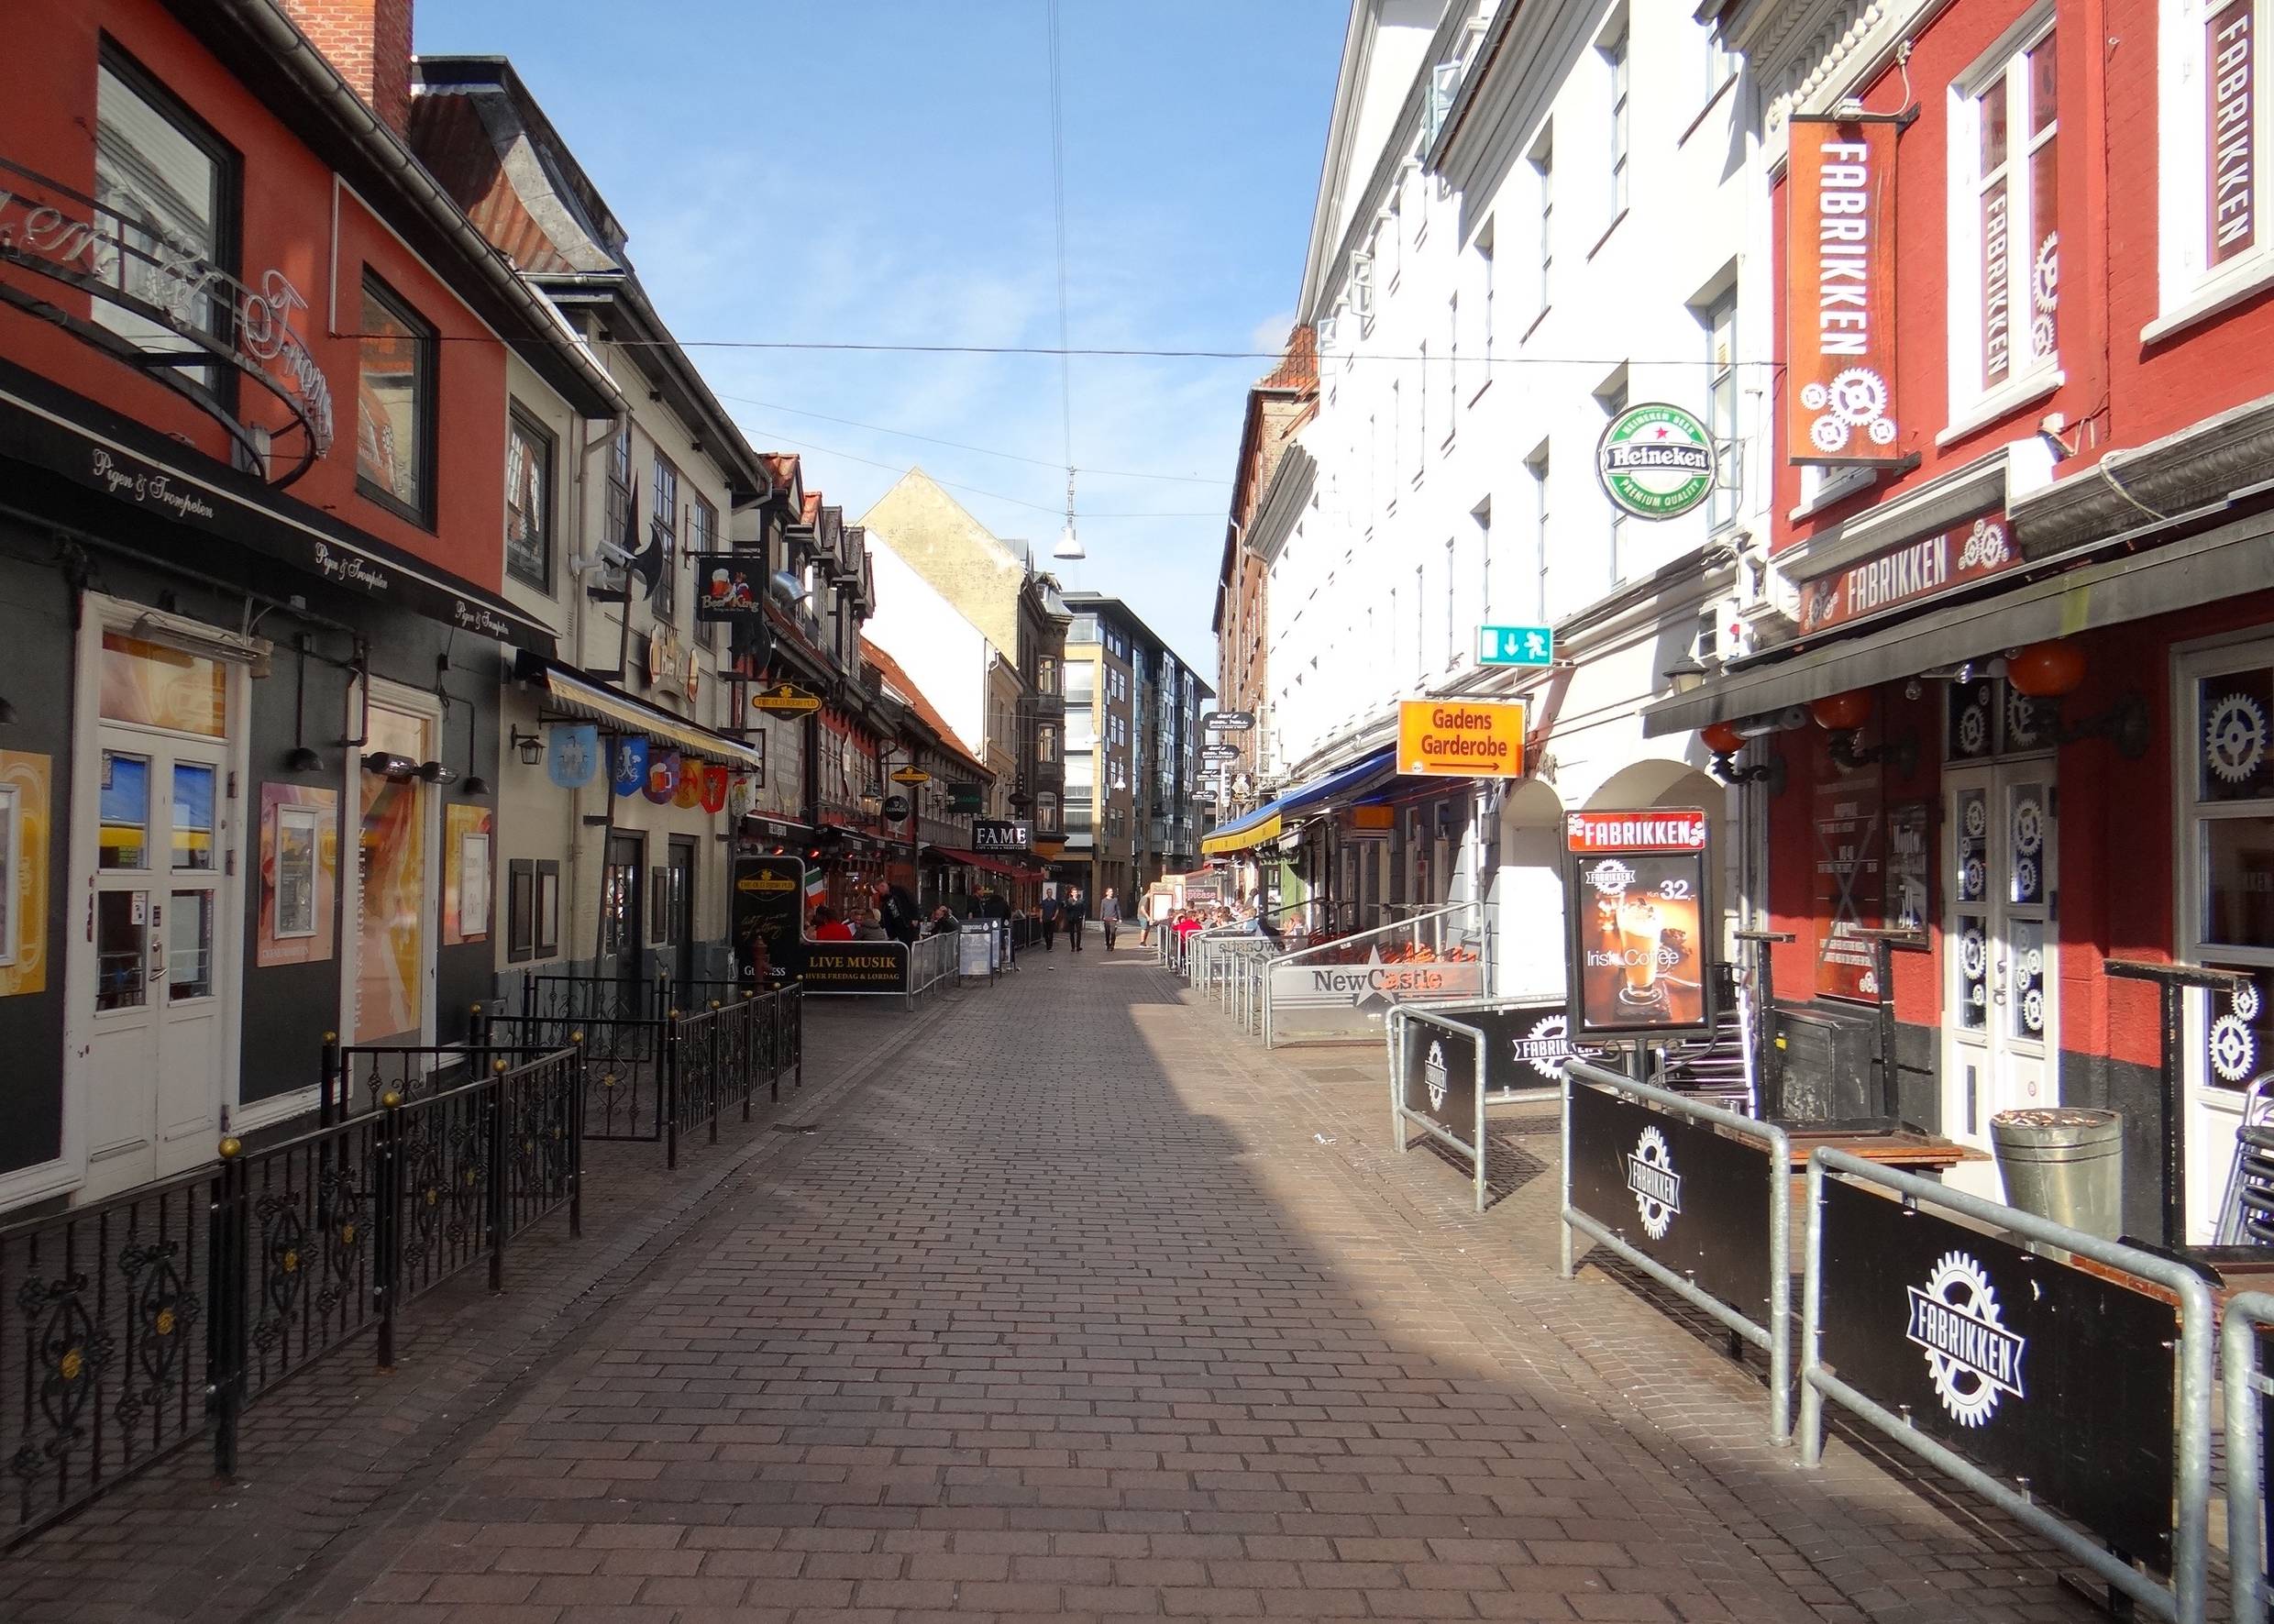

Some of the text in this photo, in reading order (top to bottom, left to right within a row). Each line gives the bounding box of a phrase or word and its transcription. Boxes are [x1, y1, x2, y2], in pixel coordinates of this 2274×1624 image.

[2217, 15, 2248, 248] FABRIKKEN
[1820, 143, 1867, 355] FABRIKKEN
[1987, 193, 2007, 376] FABRIKKEN
[1622, 413, 1670, 435] HEINEKEN
[1613, 445, 1707, 469] Heineken
[93, 448, 133, 492] Pigen
[149, 476, 214, 518] Trompeten
[1619, 480, 1700, 507] PREMIUM QUALITY
[1848, 535, 1947, 614] FABRIKKEN
[1432, 708, 1493, 730] Gadens
[1421, 735, 1507, 757] Garderobe
[977, 828, 1028, 845] FAME
[1584, 821, 1690, 845] FABRIKKEN
[1591, 872, 1631, 883] FABRIKKEN
[810, 956, 897, 967] LIVE MUSIK
[1312, 968, 1443, 991] NewCastle
[1632, 1161, 1674, 1207] FABRIKKEN
[1918, 1298, 2010, 1383] FABRIKKEN
